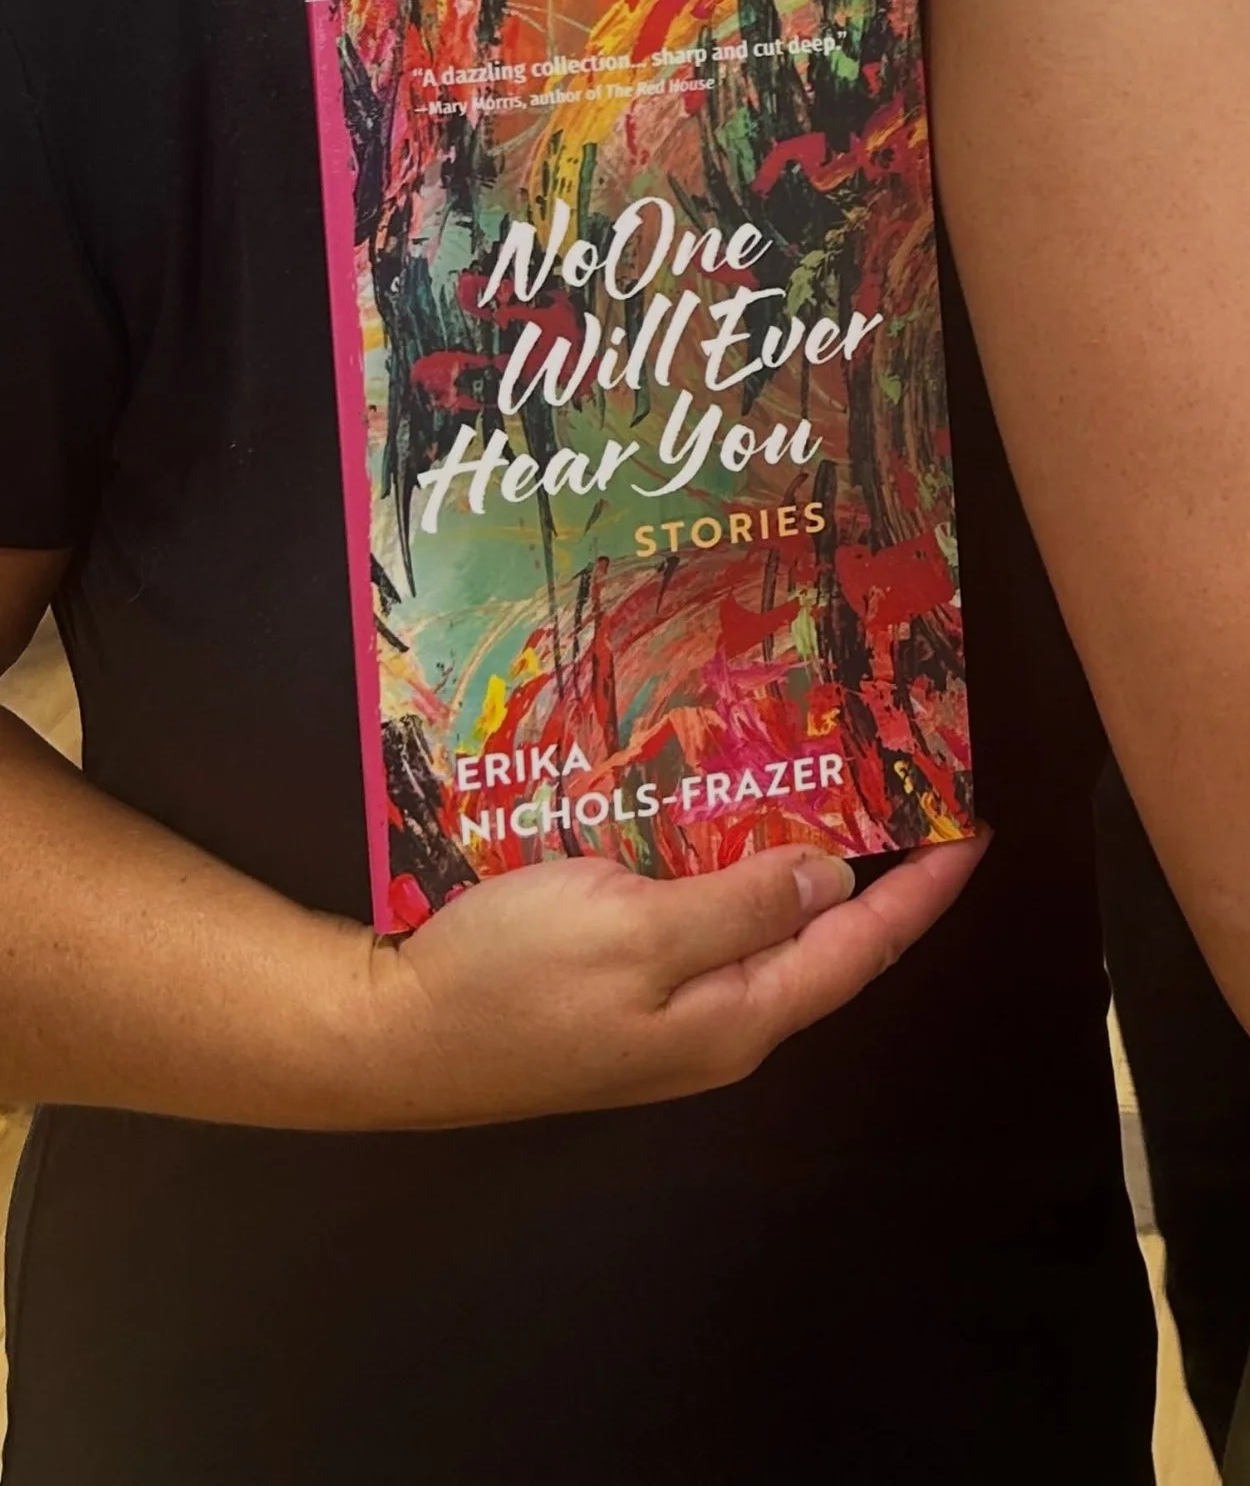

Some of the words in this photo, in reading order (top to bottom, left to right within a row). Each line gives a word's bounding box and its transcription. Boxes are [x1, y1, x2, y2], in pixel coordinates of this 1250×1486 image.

[441, 61, 526, 85] dazzling
[652, 45, 707, 67] sharp
[712, 40, 748, 61] and
[753, 38, 784, 57] cut
[473, 94, 528, 111] Morris,
[530, 89, 582, 107] author
[586, 85, 602, 101] of
[606, 83, 633, 99] The
[637, 79, 665, 95] Red
[669, 77, 716, 93] House
[498, 292, 701, 415] Will
[701, 286, 884, 391] Ever
[418, 424, 640, 534] Hear
[632, 389, 822, 498] You
[634, 501, 826, 557] STORIES
[456, 743, 592, 792] ERIKA
[459, 753, 845, 846] NICHOLS-FRAZER
